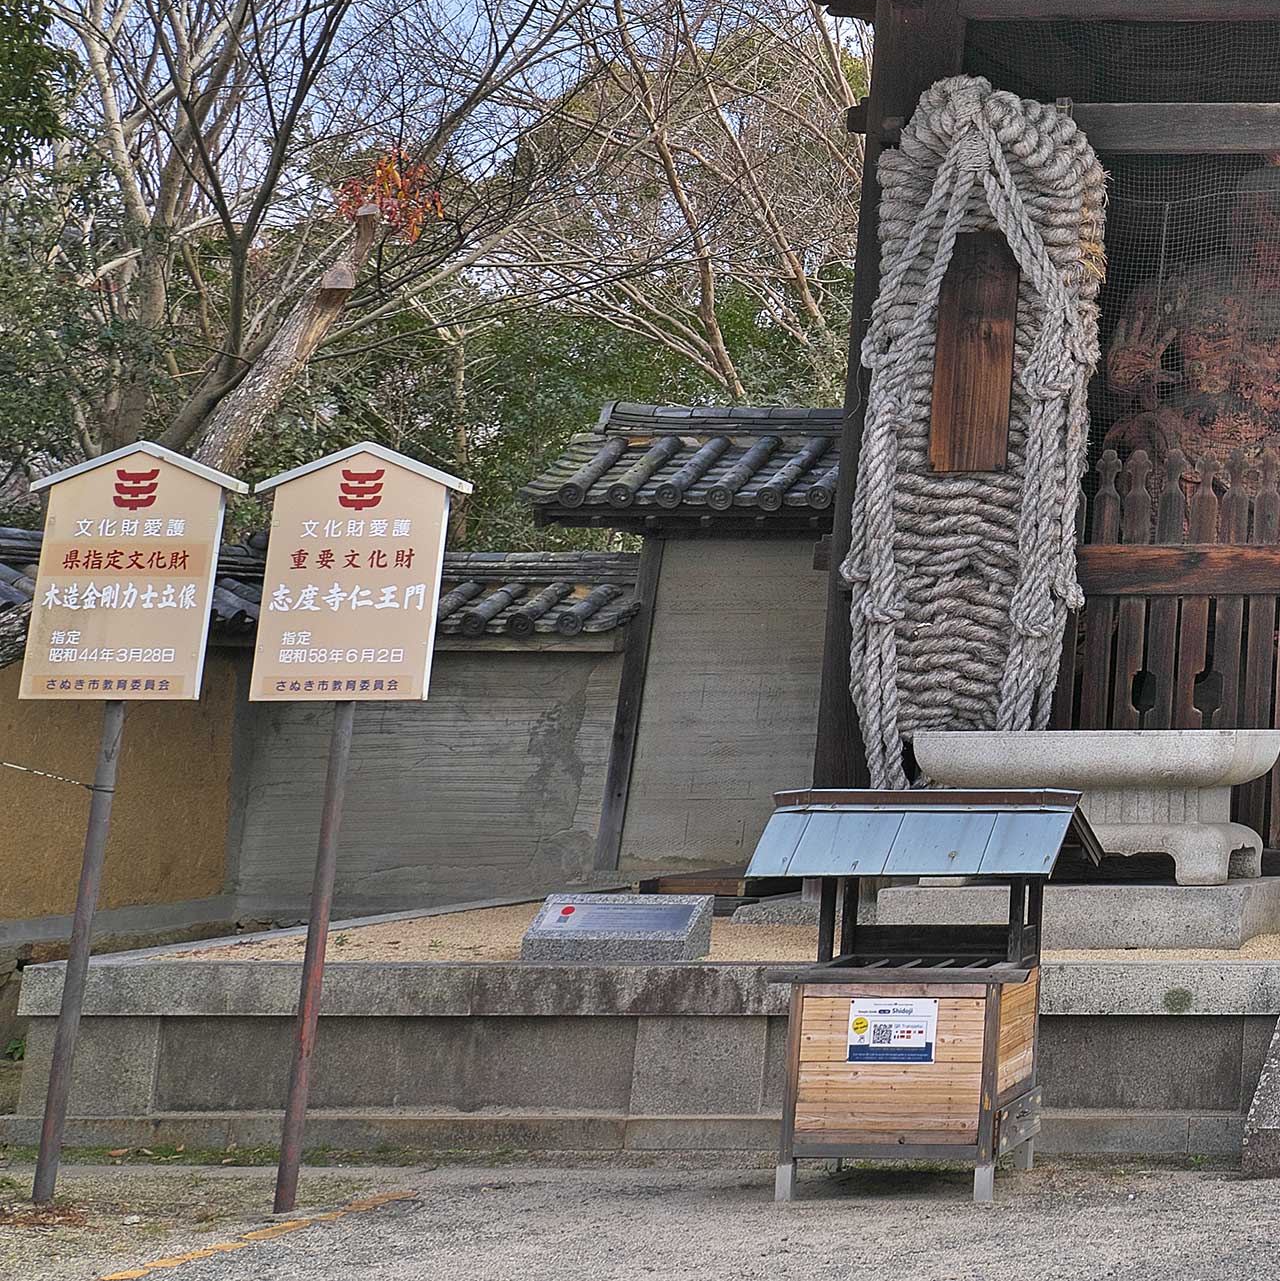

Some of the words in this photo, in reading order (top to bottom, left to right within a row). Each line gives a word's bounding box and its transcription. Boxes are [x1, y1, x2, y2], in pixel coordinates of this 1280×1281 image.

[74, 519, 186, 537] 文化財愛護
[300, 519, 412, 538] 文化財愛護
[62, 549, 190, 570] 県指定文化財
[289, 548, 416, 570] 重要文化財
[42, 582, 198, 609] 木造金剛力士立像
[268, 582, 427, 612] 志度寺仁王門
[50, 631, 81, 645] 指定
[281, 631, 312, 646] 指定
[48, 648, 175, 663] 昭和44年3月28日
[278, 648, 404, 663] 昭和58年6月2日
[46, 679, 170, 691] さぬき市教育委員会
[275, 679, 399, 692] さぬき市教育委員会
